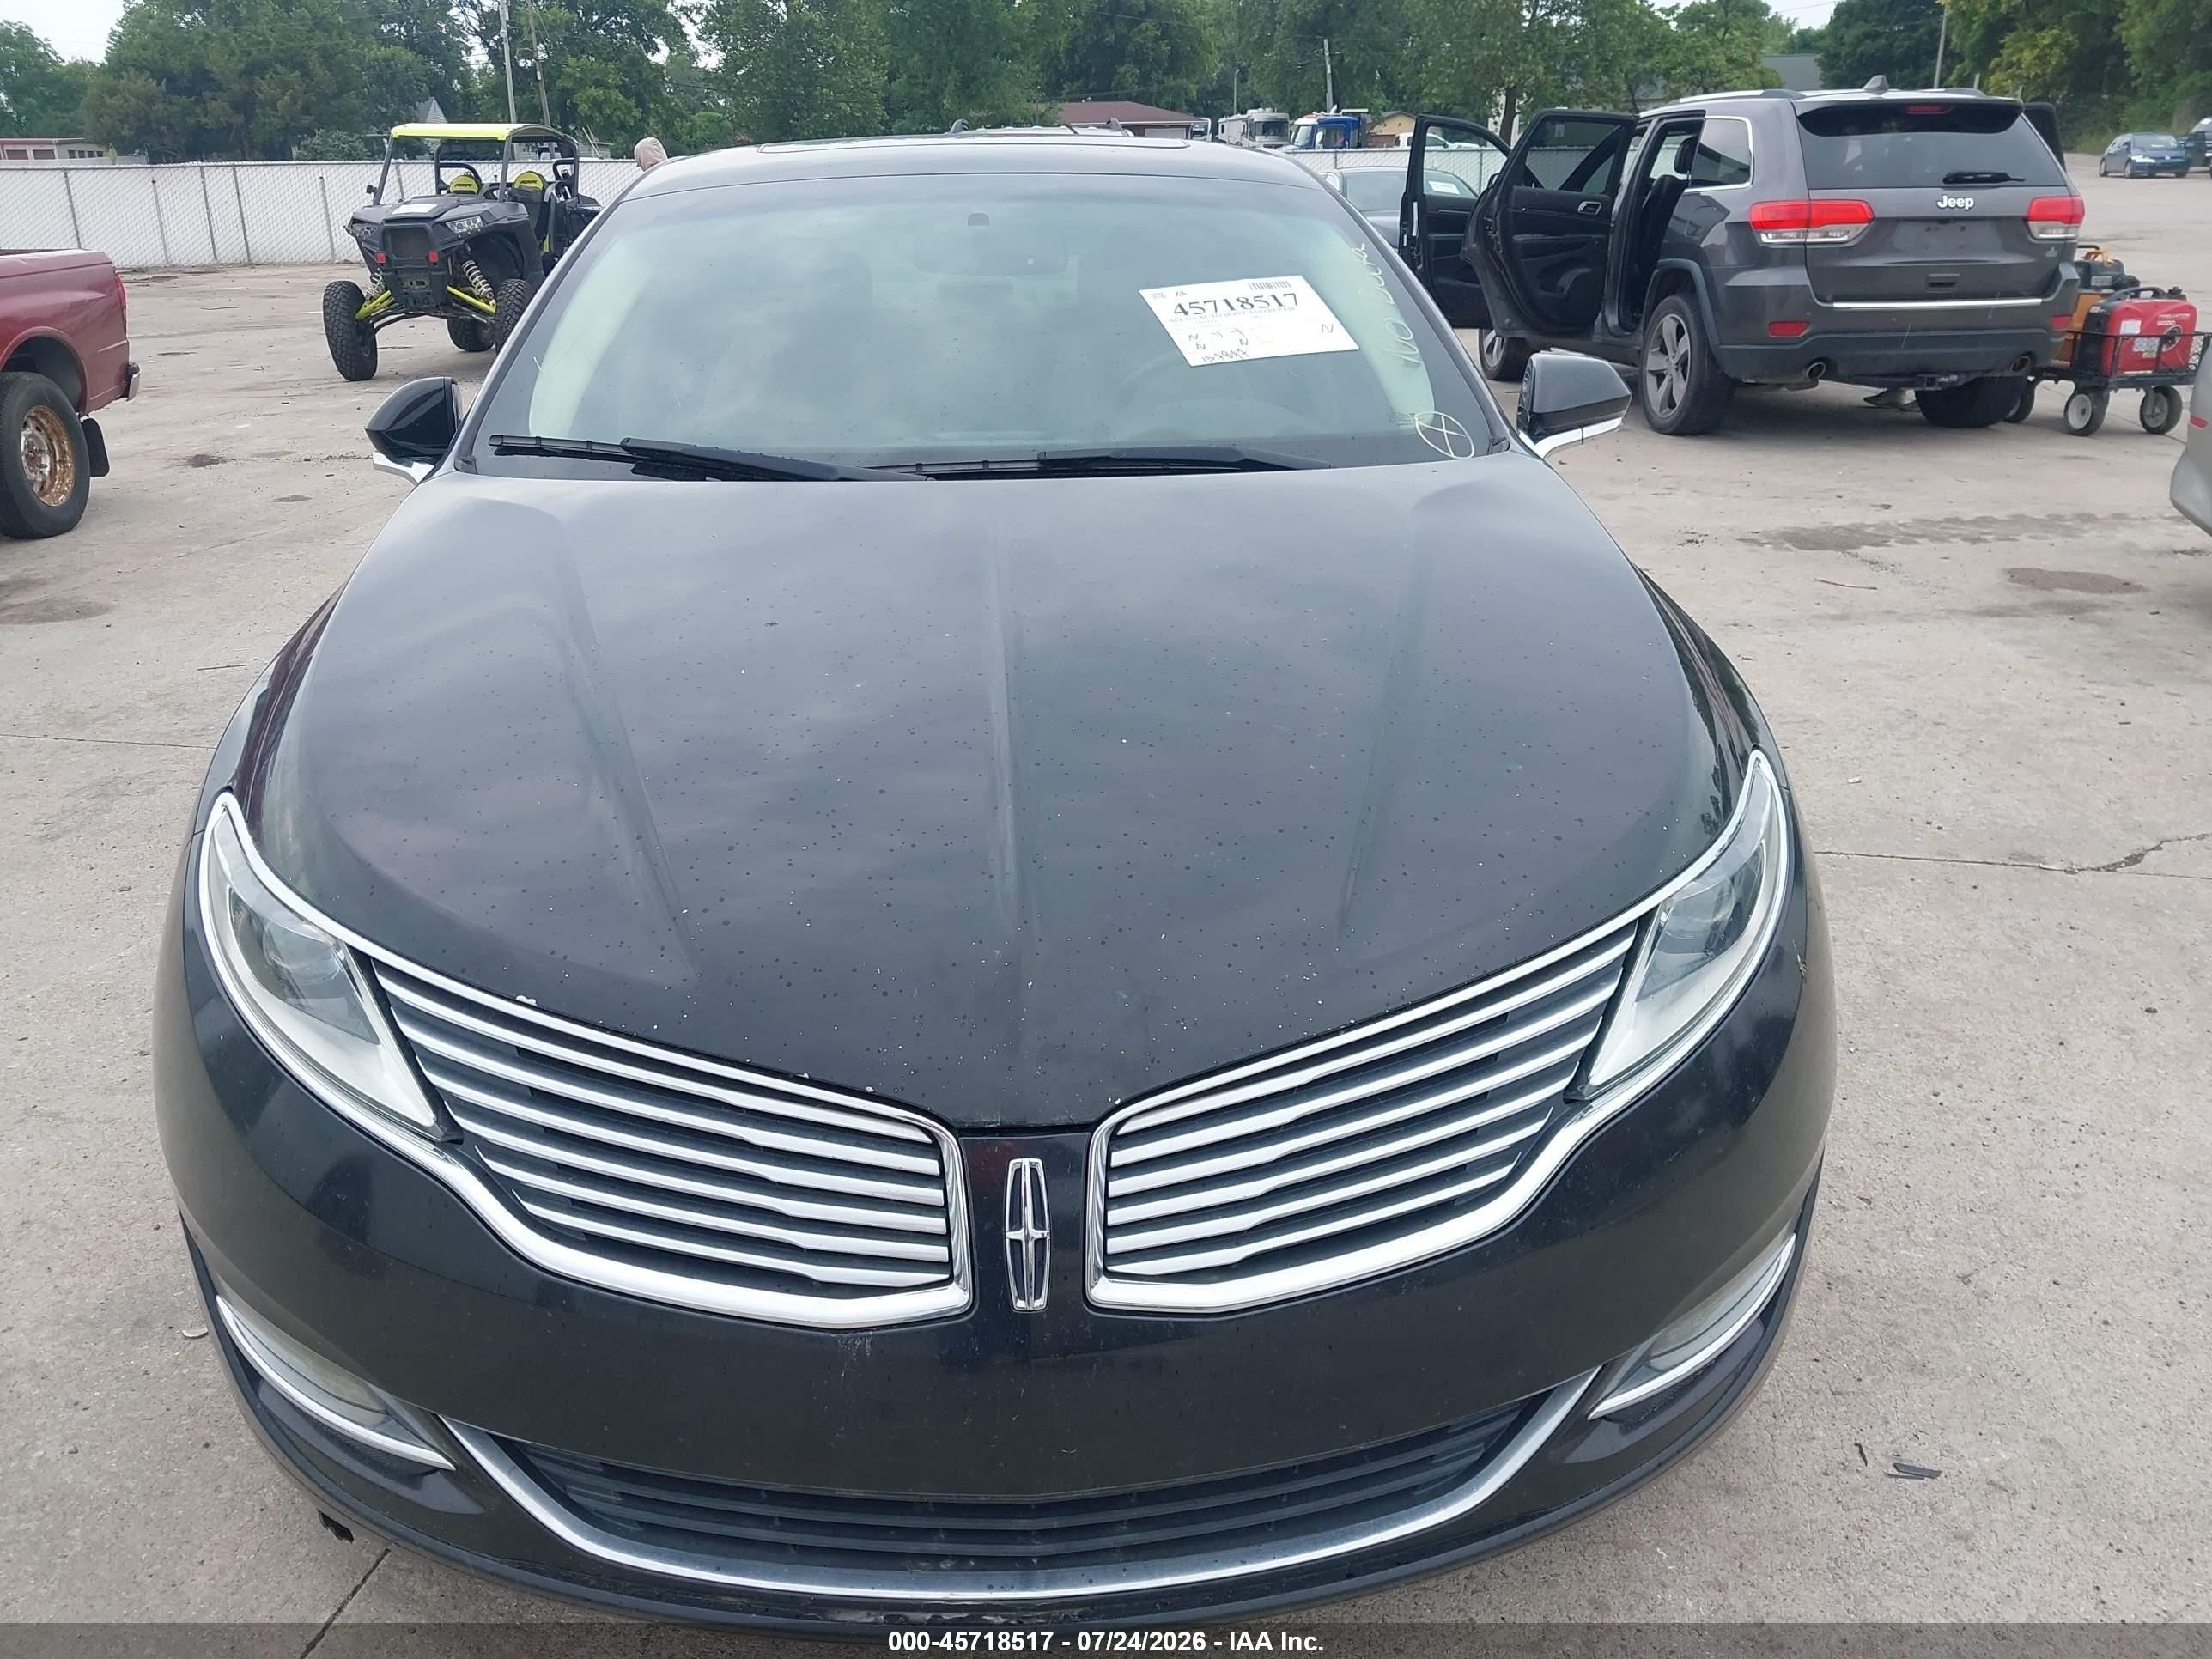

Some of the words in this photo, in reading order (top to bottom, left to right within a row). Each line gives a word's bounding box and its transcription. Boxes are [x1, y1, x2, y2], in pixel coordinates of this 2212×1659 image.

[1937, 195, 1974, 210] Jeep
[1174, 292, 1297, 316] 45718517
[1321, 324, 1333, 333] N
